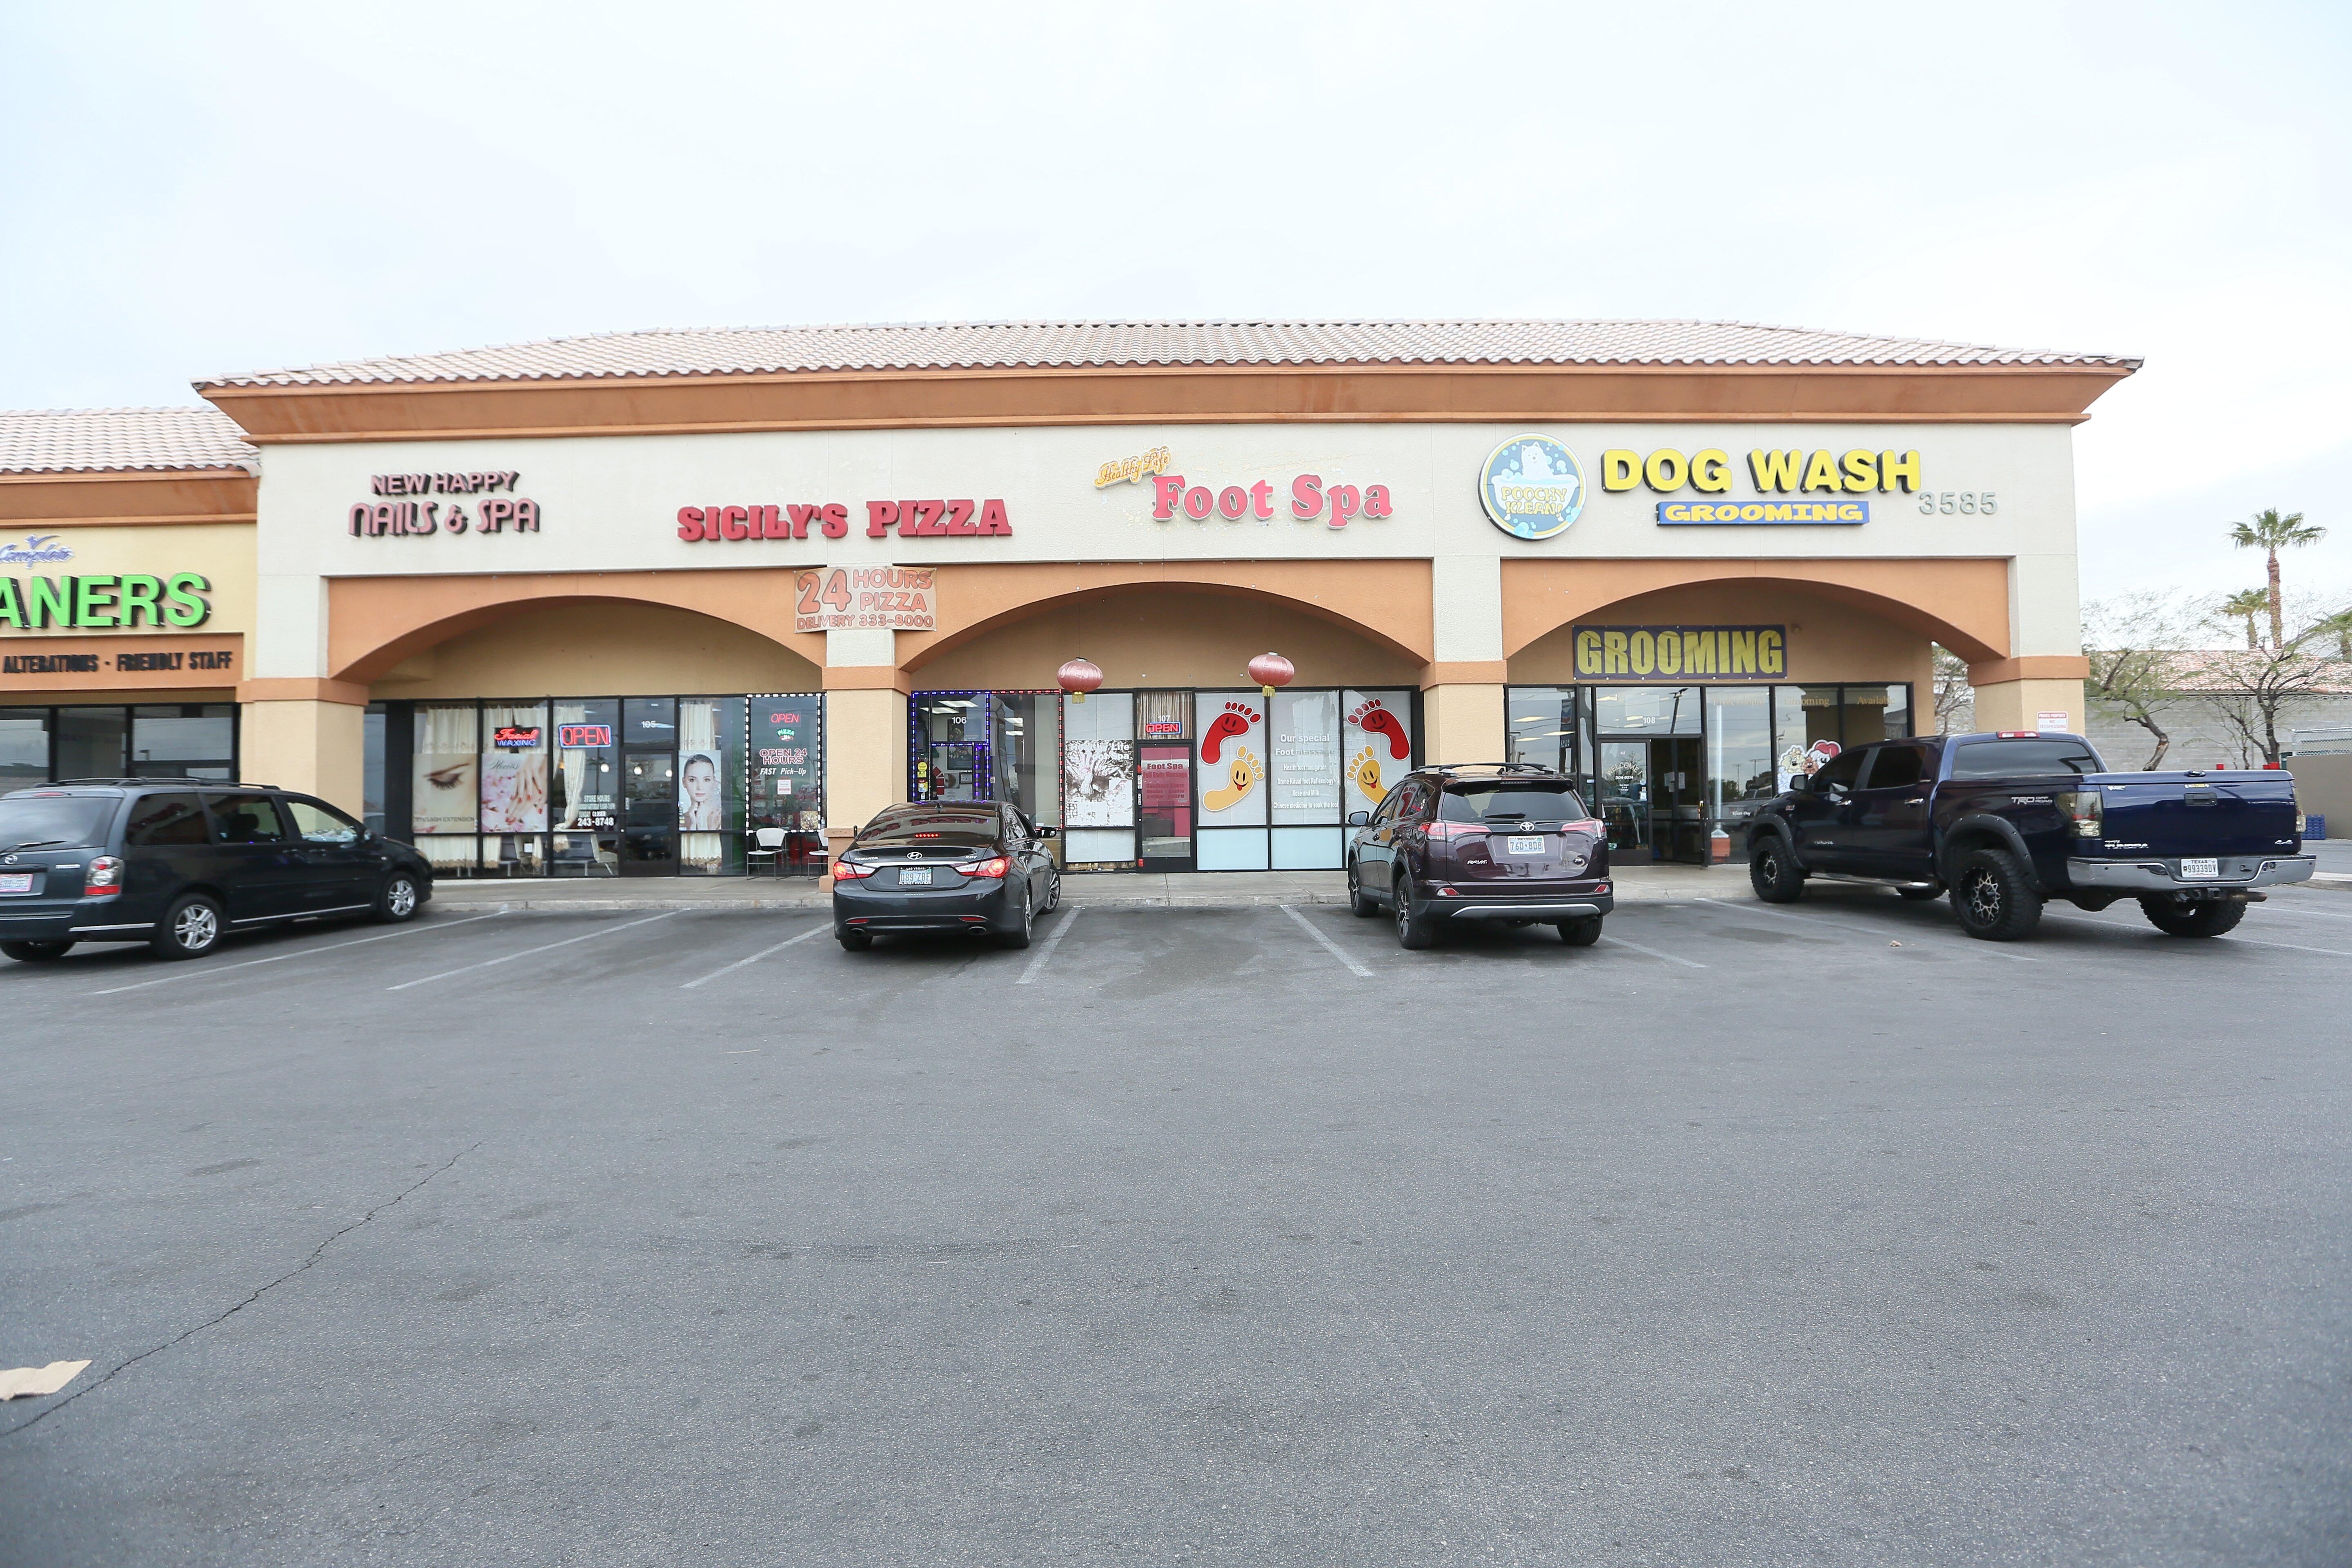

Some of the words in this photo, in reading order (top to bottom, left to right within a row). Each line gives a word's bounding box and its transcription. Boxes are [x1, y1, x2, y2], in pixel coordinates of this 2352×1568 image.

[1097, 459, 1141, 485] Healthy
[1144, 448, 1168, 472] Life
[1601, 448, 1733, 493] DOG
[1747, 448, 1921, 494] WASH
[371, 473, 431, 495] NEW
[433, 470, 519, 492] HAPPY
[1152, 475, 1274, 521] Foot
[1290, 474, 1393, 530] Spa
[1501, 486, 1567, 502] POOCHY
[1920, 492, 1998, 514] 3585
[348, 500, 438, 537] NAILS
[443, 504, 468, 534] &
[475, 497, 540, 534] SPA
[1505, 501, 1563, 518] KLEAN!
[1665, 504, 1863, 522] GROOMING
[677, 503, 848, 542] SICILY'S
[866, 499, 1013, 538] PIZZA
[0, 573, 210, 628] ANERS
[797, 569, 852, 614] 24
[853, 569, 932, 589] HOURS
[859, 592, 927, 612] PIZZA
[797, 615, 855, 629] DELIVERY
[859, 614, 933, 628] 333-8000
[4, 655, 98, 673] ALTERATIONS
[117, 653, 183, 671] FRIENDLY
[189, 651, 232, 670] STAFF
[1577, 630, 1783, 675] GROOMING
[771, 713, 799, 723] OPEN
[1146, 724, 1178, 732] OPEN
[561, 726, 610, 745] OPEN
[1298, 734, 1330, 743] special
[760, 749, 791, 757] OPEN
[794, 748, 807, 757] 24
[763, 756, 804, 765] HOURS
[577, 817, 614, 826] 243-8748
